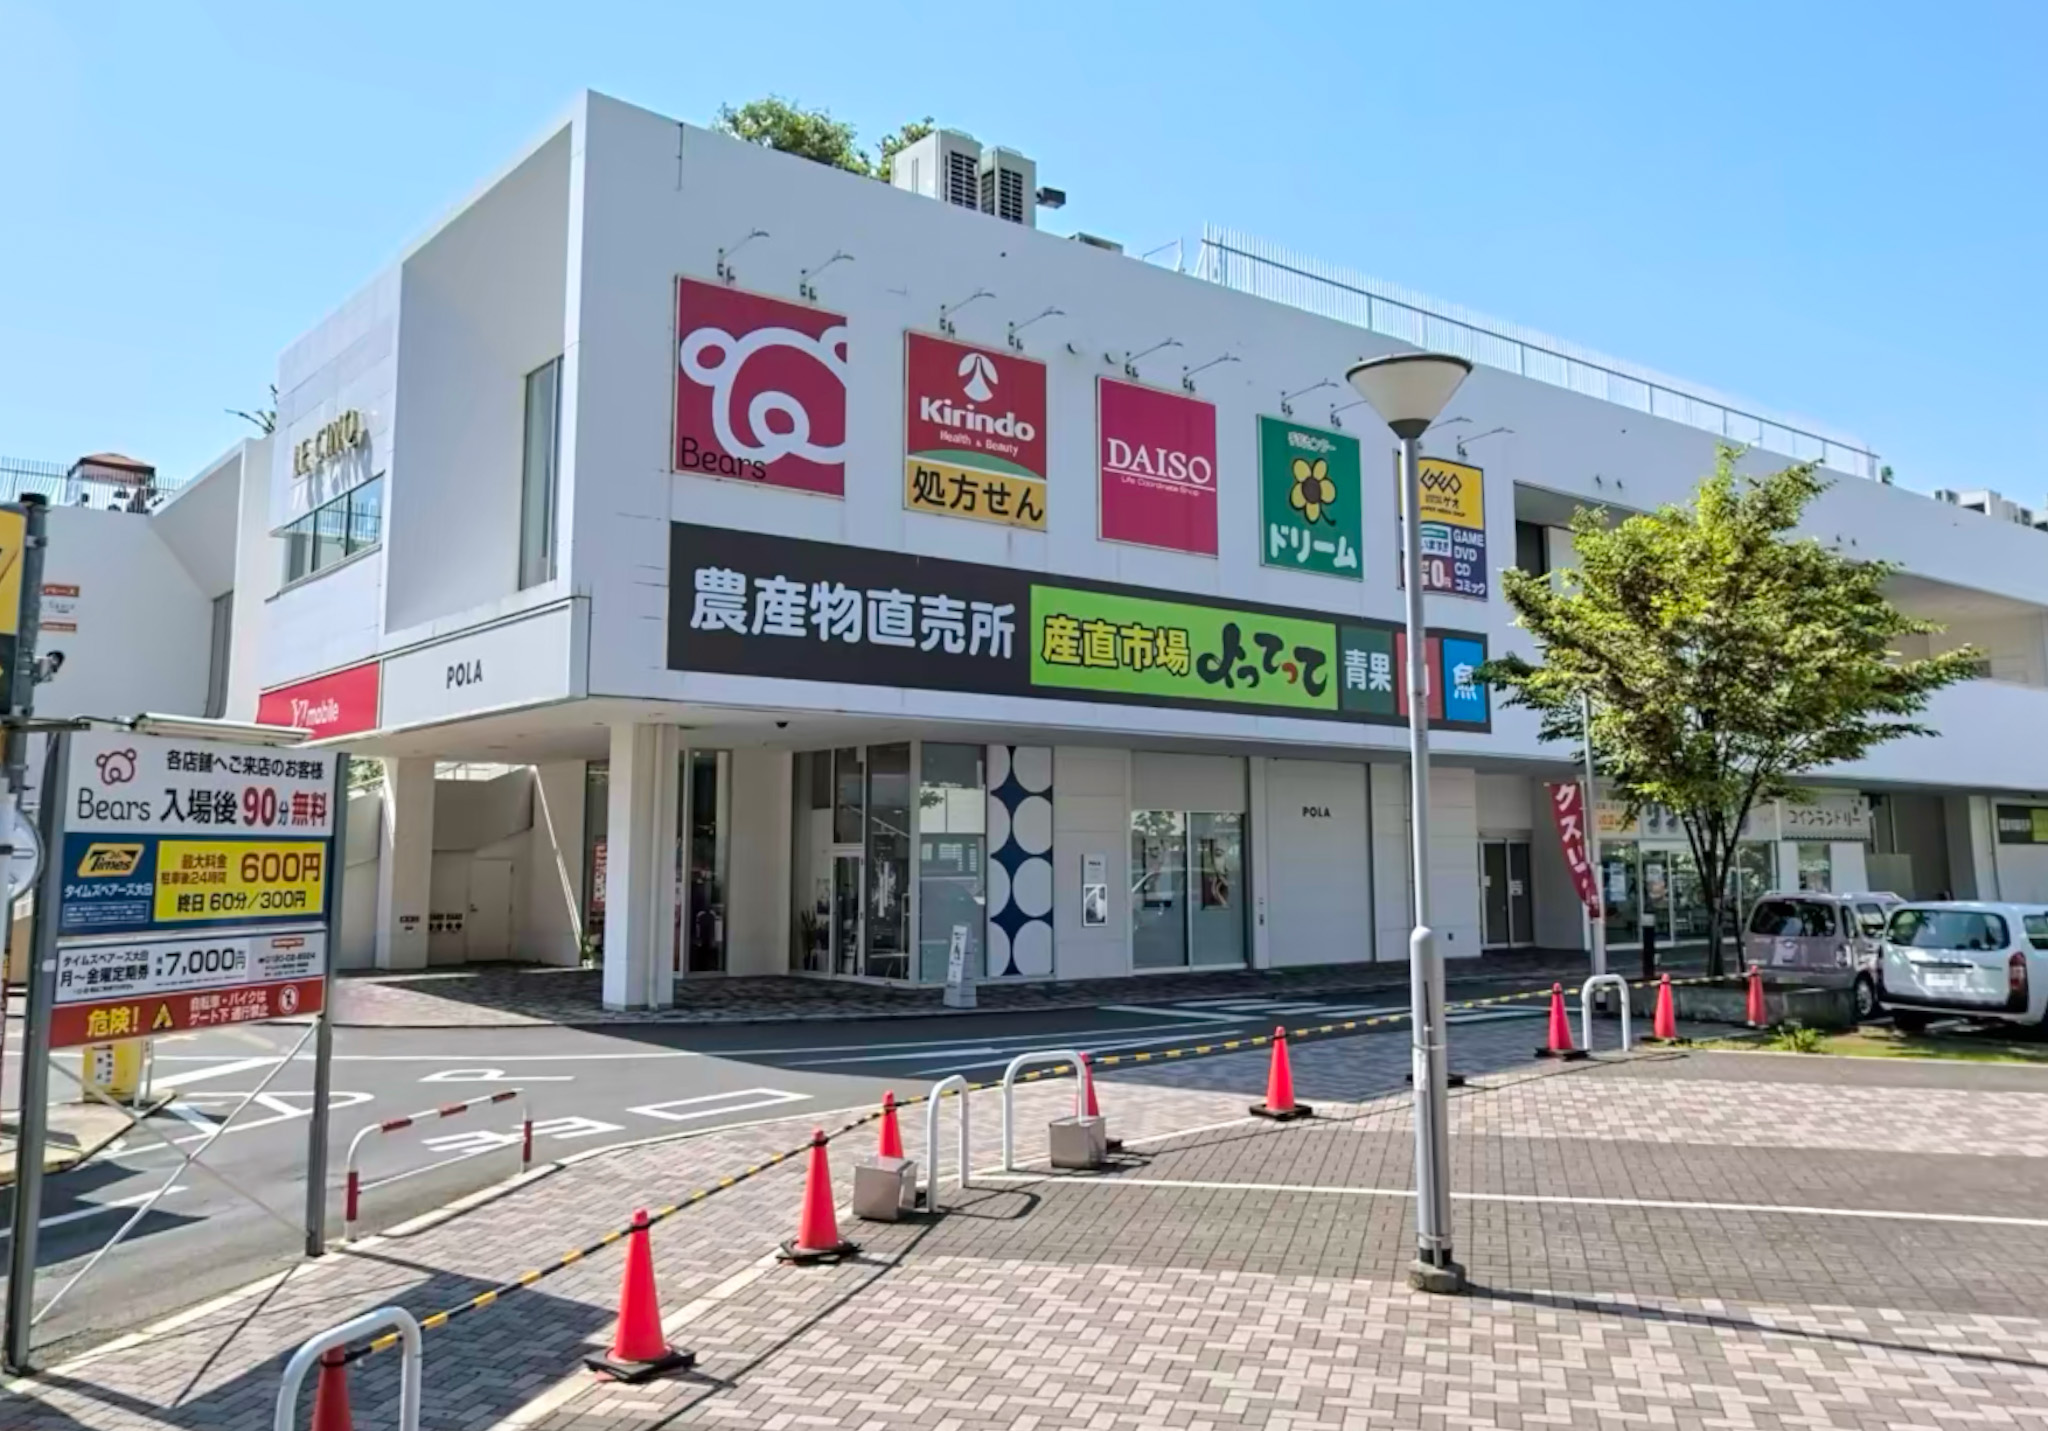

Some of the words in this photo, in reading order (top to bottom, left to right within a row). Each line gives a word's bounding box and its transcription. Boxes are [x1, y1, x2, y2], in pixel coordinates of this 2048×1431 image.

[920, 395, 1036, 442] Kirindo
[681, 436, 767, 481] Bears
[940, 430, 972, 447] Health
[985, 439, 1019, 458] Beauty
[1107, 438, 1212, 485] DAISO
[913, 465, 1043, 521] 処方せん
[1420, 467, 1463, 495] GEO
[1270, 523, 1358, 569] ドリーム
[1453, 528, 1485, 547] GAME
[1454, 546, 1478, 562] DVD
[1454, 562, 1472, 577] CD
[1455, 578, 1486, 595] コミック
[690, 566, 1016, 660] 農産物直売所
[1041, 612, 1190, 676] 産直市場
[1196, 622, 1328, 697] よってって
[446, 659, 483, 689] POLA
[1345, 648, 1392, 692] 青果
[167, 749, 324, 780] 各店舗へご来店のお客様
[78, 787, 150, 822] Bears
[1302, 805, 1331, 818] POLA
[1788, 809, 1862, 828] コインランドリー
[89, 851, 132, 872] Times
[241, 852, 321, 883] 600円
[177, 893, 204, 912] 終日
